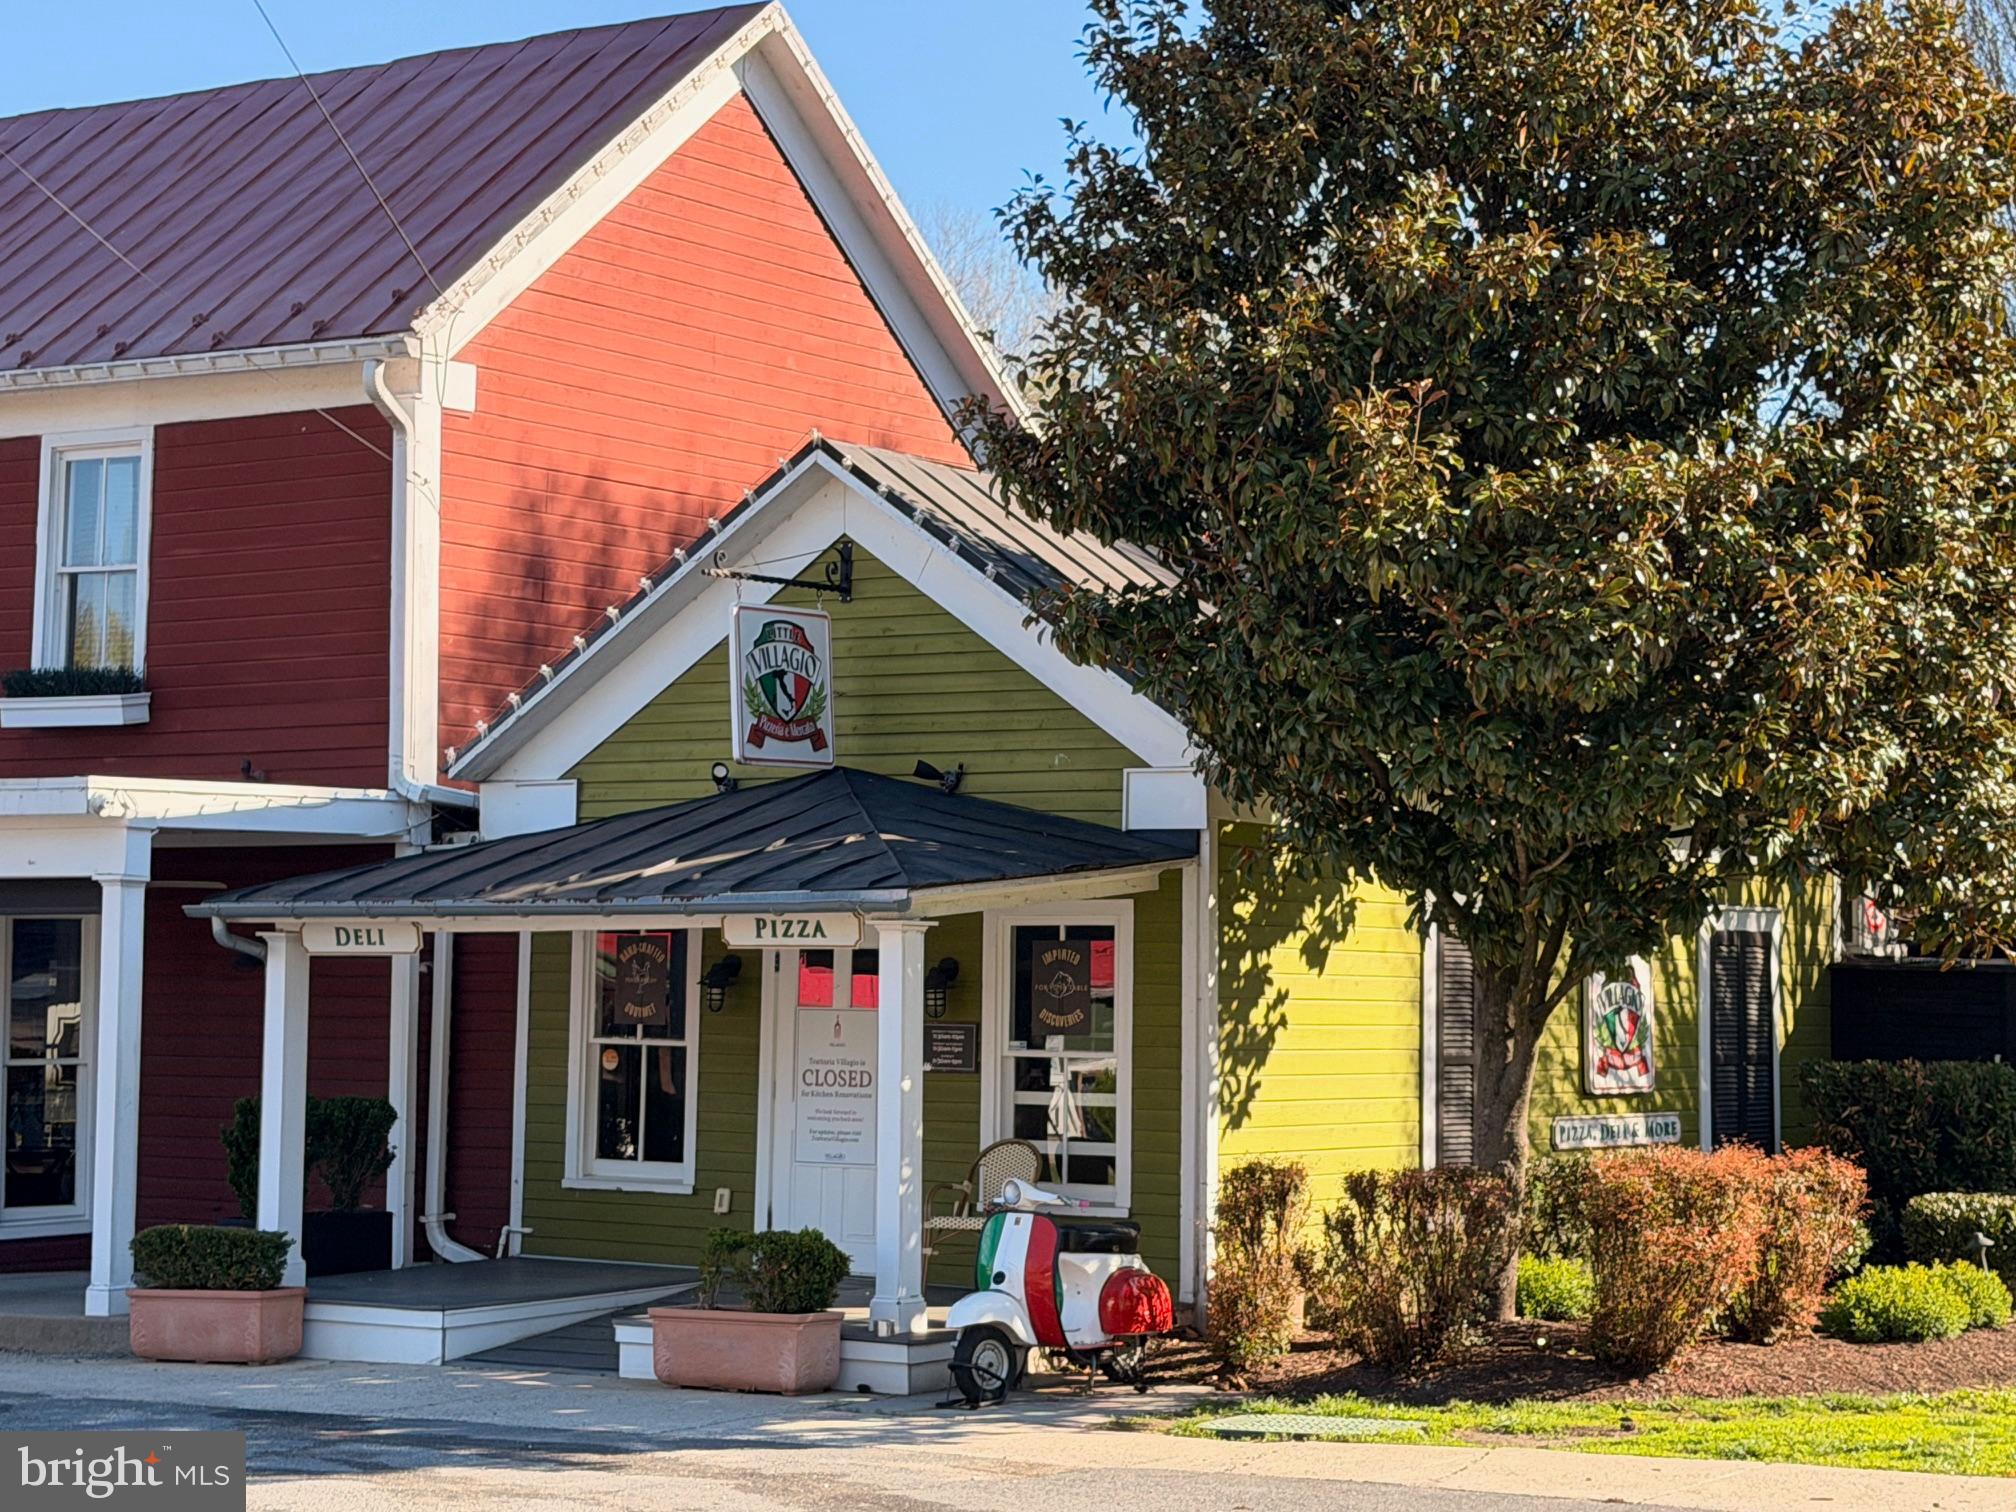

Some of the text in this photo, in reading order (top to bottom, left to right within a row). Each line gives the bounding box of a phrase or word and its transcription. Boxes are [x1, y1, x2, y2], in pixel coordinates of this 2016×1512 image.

[750, 645, 817, 678] VILLAGIO
[334, 926, 385, 946] DELI
[754, 917, 828, 939] PIZZA
[1041, 948, 1081, 966] IMPORTED
[1039, 1008, 1085, 1028] DISCOVERIES
[802, 1069, 872, 1088] CLOSED
